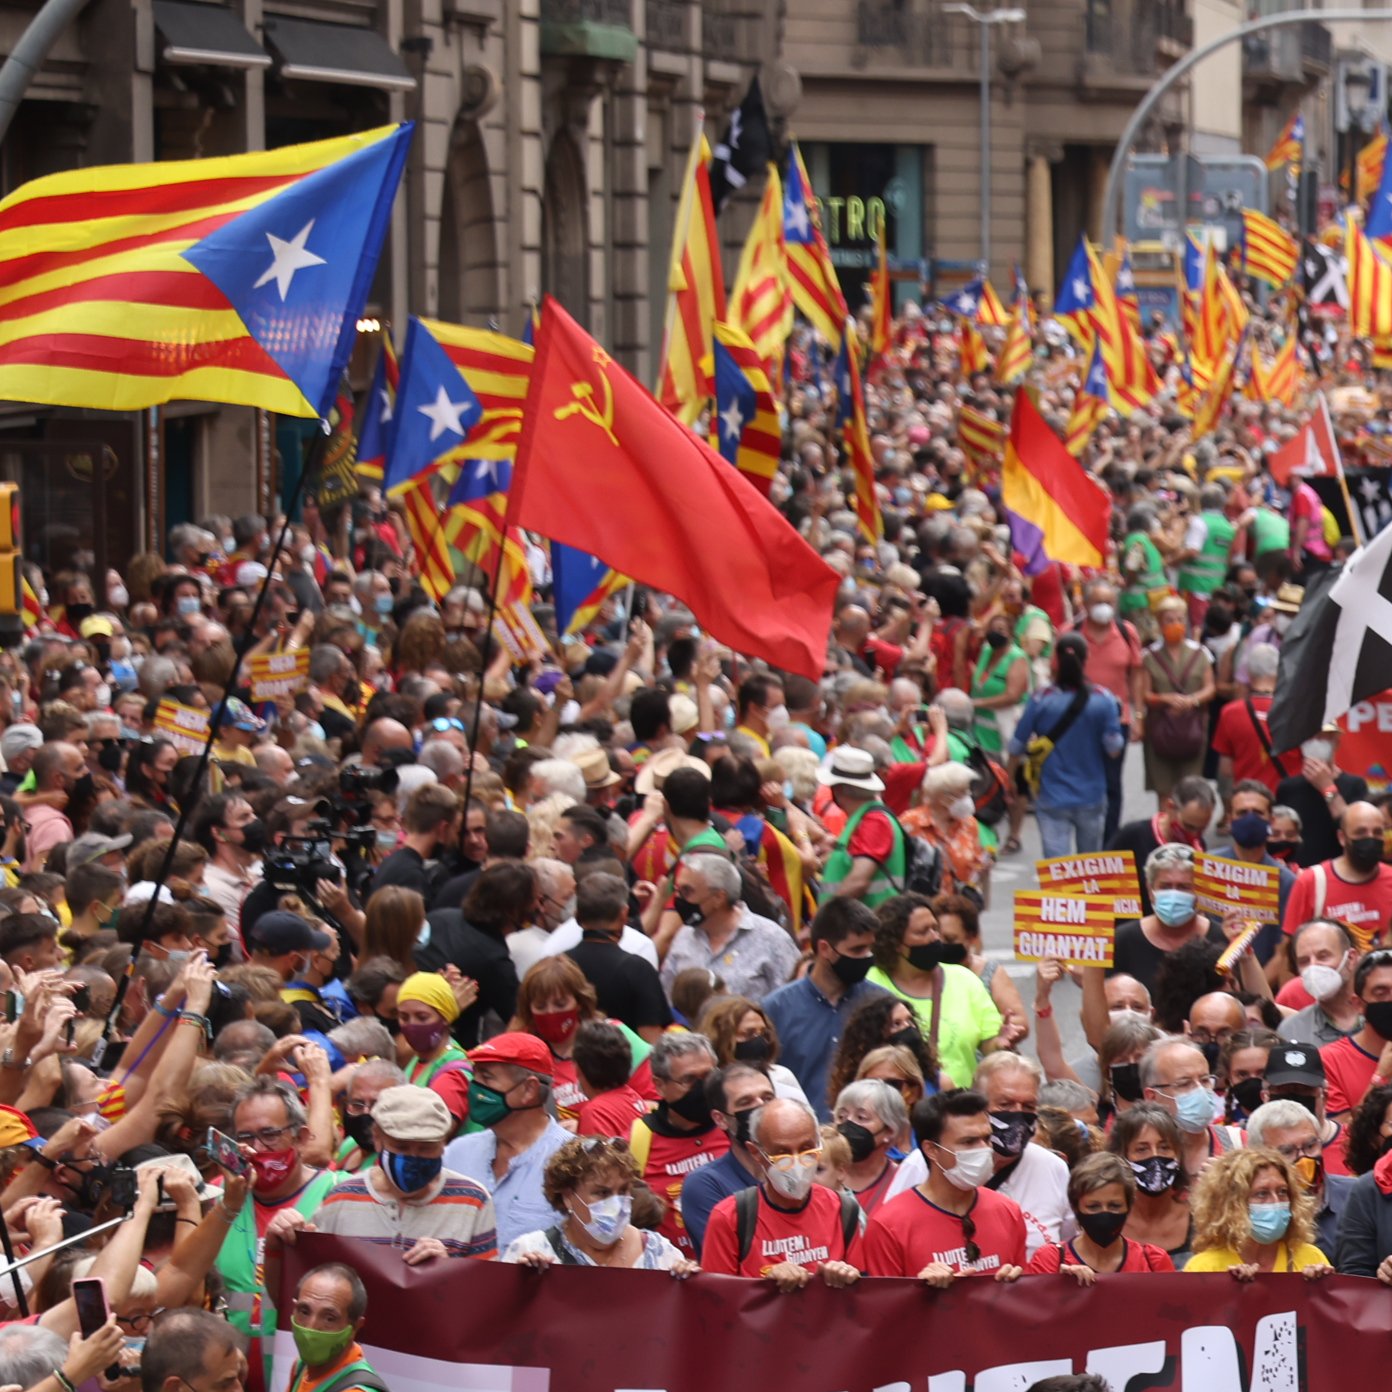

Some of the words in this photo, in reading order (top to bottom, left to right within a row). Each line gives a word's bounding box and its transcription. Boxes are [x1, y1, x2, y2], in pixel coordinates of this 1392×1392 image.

[1049, 857, 1125, 881] EXIGIM
[1202, 858, 1268, 888] EXIGIM
[1083, 878, 1100, 894] LA
[1226, 884, 1241, 901] LA
[1041, 897, 1087, 924] HEM
[1019, 932, 1109, 961] GUANYAT
